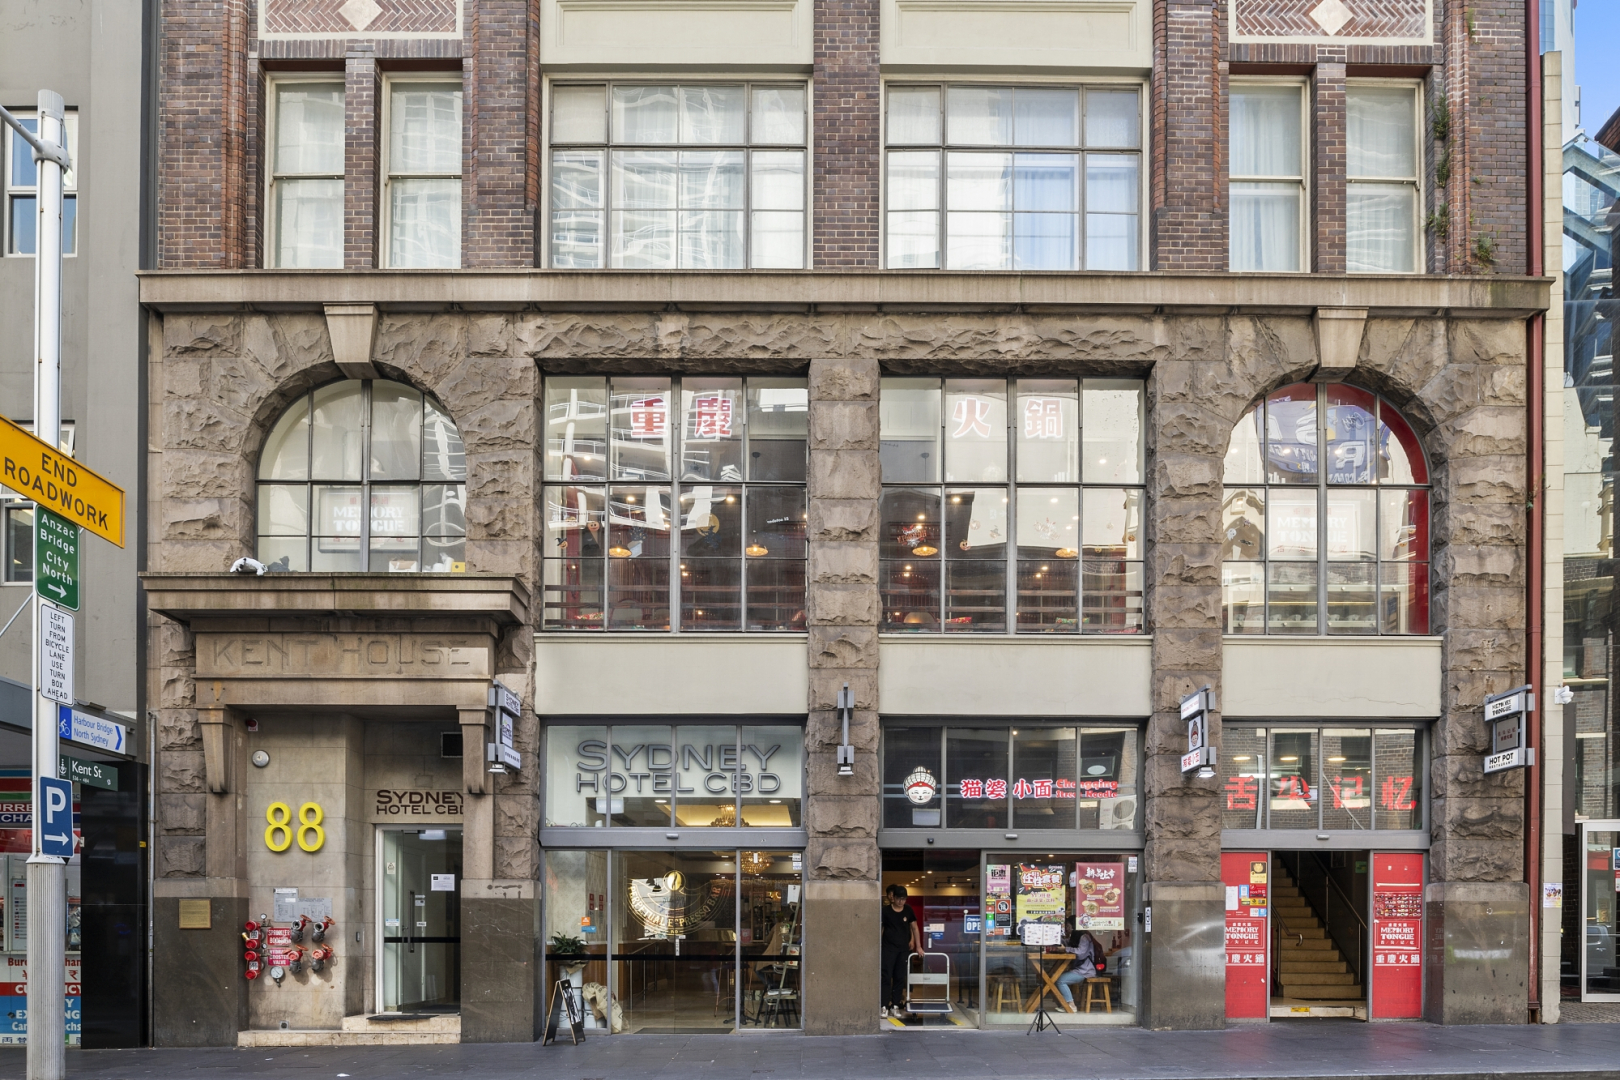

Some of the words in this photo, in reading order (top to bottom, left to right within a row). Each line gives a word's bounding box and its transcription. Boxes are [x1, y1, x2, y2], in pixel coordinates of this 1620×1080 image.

[42, 452, 76, 487] END
[4, 456, 108, 530] ROADWORK
[42, 513, 75, 538] Anzac
[333, 520, 404, 531] TOGUE
[1277, 517, 1348, 528] MEMRY
[40, 528, 75, 554] Bridge
[1277, 531, 1347, 542] TONUE
[46, 551, 69, 570] City
[42, 563, 73, 586] North
[51, 612, 64, 623] LEFT
[50, 621, 65, 633] TURN
[50, 631, 65, 642] FROM
[46, 638, 69, 653] BICYCLE
[212, 638, 321, 669] KENT
[340, 638, 471, 667] HOUSE
[50, 650, 65, 661] LANE
[52, 660, 63, 670] USE
[50, 669, 65, 680] TURN
[52, 679, 63, 688] BOX
[47, 688, 68, 699] AHEAD
[74, 715, 95, 729] Harbour
[97, 722, 113, 735] Bridge
[74, 728, 89, 740] North
[91, 733, 109, 747] Sydney
[576, 740, 781, 771] SYDNEY
[1489, 756, 1500, 764] HOT
[1502, 752, 1514, 761] POT
[72, 761, 92, 776] Kent
[94, 765, 102, 778] St
[576, 772, 694, 793] HOTEL
[704, 772, 781, 793] CBD
[46, 786, 66, 823] P
[376, 805, 431, 814] HOTEL
[264, 802, 325, 852] 88
[629, 886, 666, 926] PERPETUAL
[707, 886, 722, 906] BAR
[1376, 954, 1420, 963] 重慶火鍋
